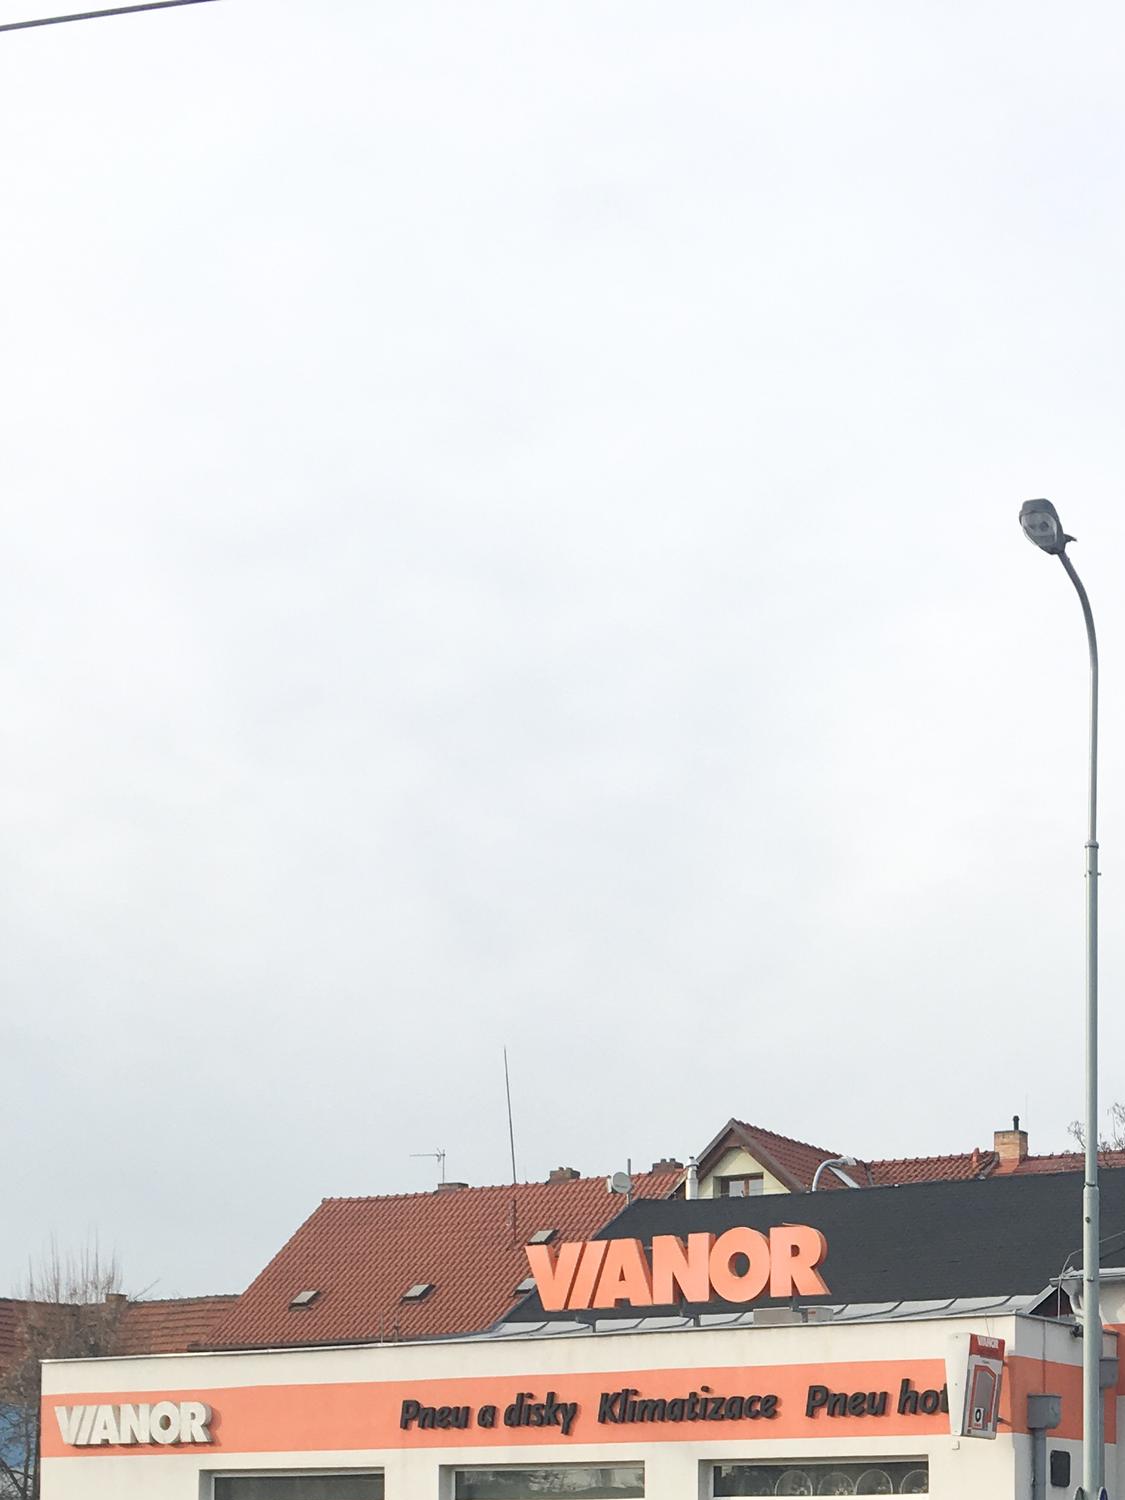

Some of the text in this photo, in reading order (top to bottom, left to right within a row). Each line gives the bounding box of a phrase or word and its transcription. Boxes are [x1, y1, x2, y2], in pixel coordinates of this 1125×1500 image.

[525, 1225, 830, 1312] VIANOR
[54, 1401, 212, 1446] VIANOR
[400, 1378, 950, 1435] Pneu a disky Klimatizace Pneu hot
